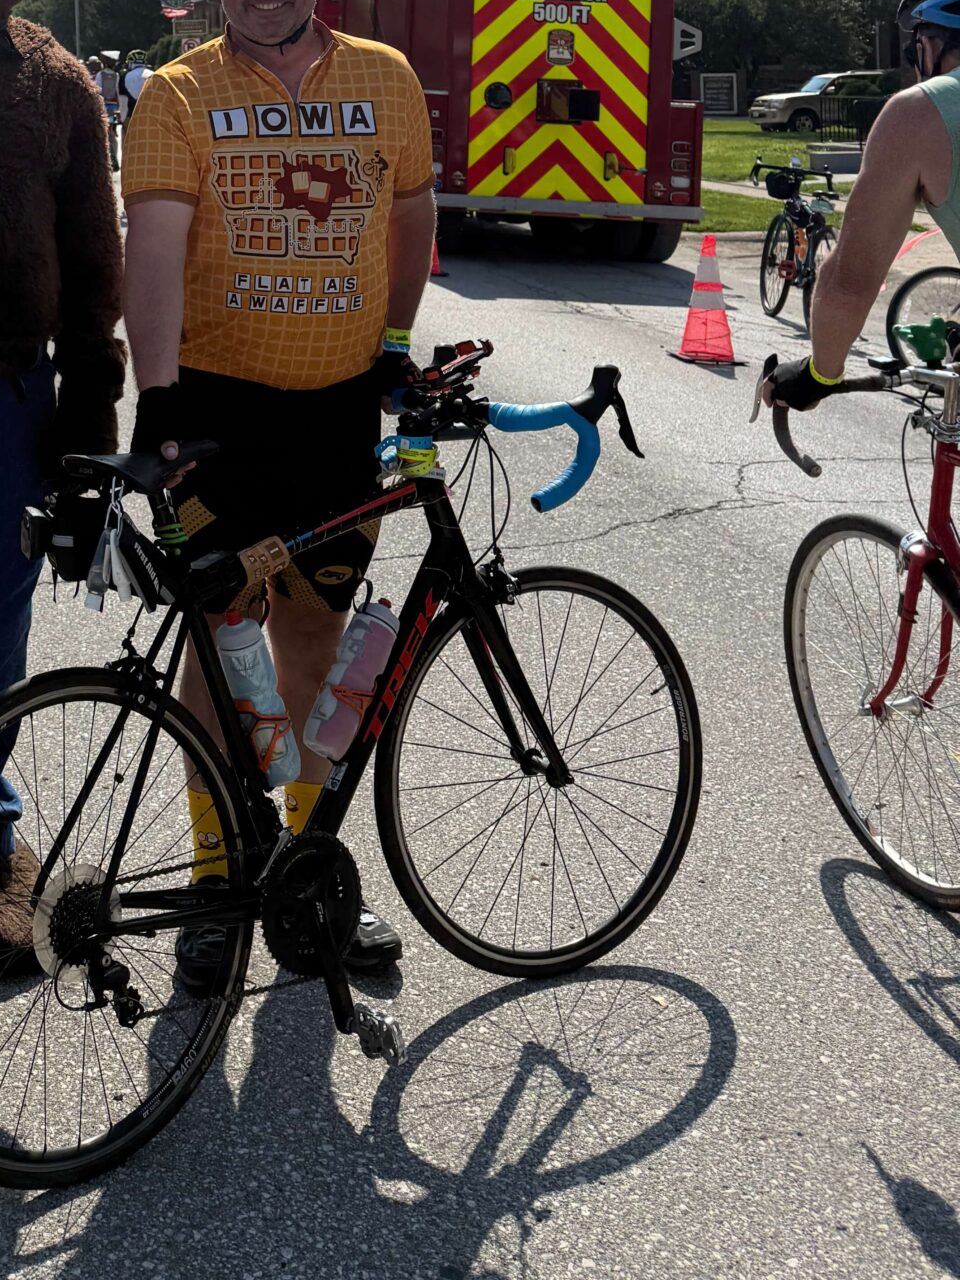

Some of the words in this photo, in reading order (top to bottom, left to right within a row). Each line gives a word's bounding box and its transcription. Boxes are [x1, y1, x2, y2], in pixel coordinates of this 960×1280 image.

[533, 3, 568, 23] 500
[571, 5, 591, 24] FT
[220, 103, 373, 132] IOWA
[236, 274, 309, 291] FLAT
[325, 276, 357, 291] AS
[228, 293, 240, 307] A
[251, 295, 362, 312] WAFFLE
[362, 587, 441, 743] TREK
[172, 1049, 198, 1086] R460
